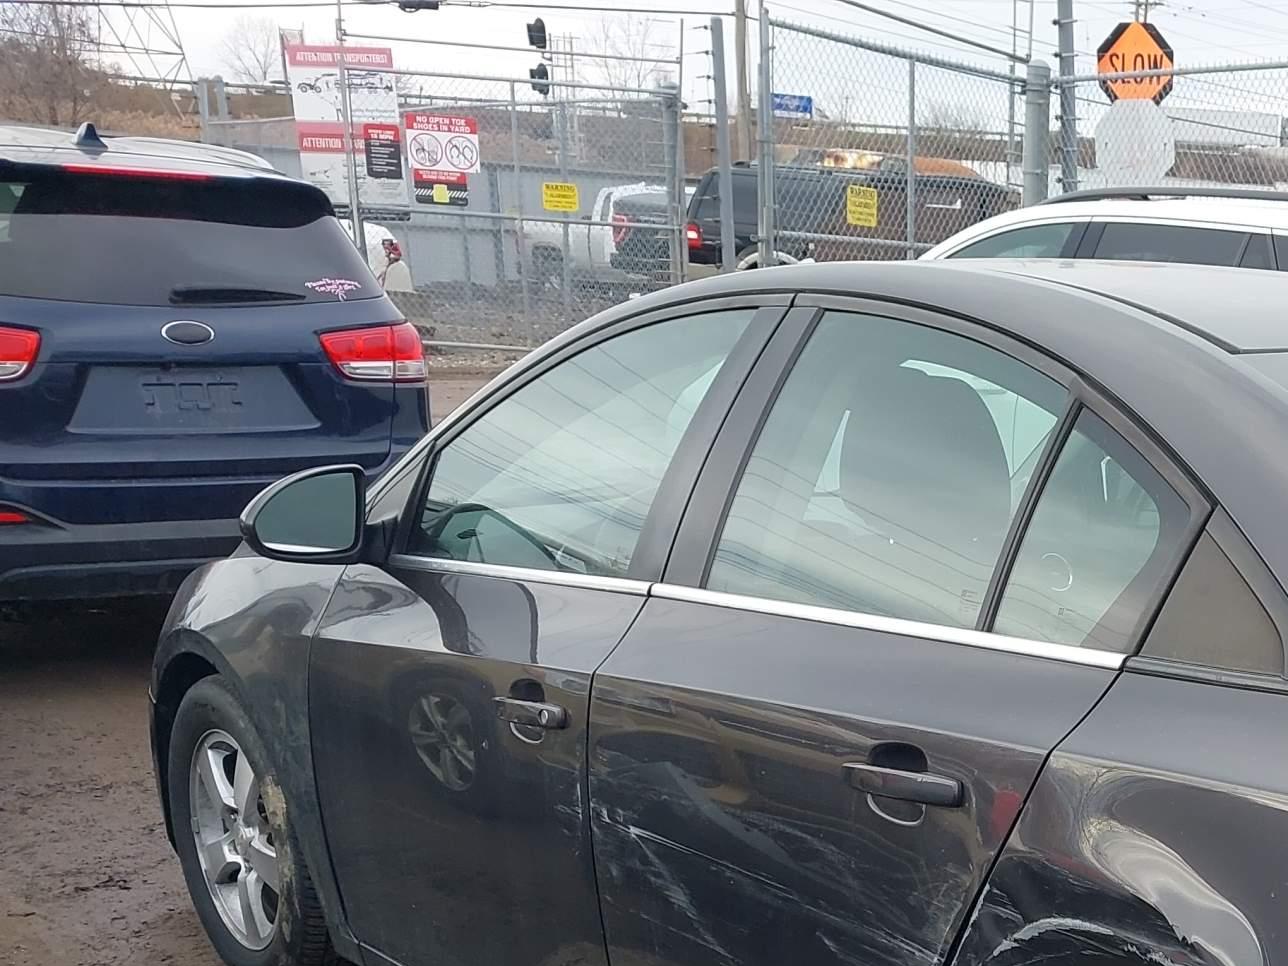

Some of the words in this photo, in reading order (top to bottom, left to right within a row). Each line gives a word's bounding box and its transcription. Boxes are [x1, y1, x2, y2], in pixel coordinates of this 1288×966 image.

[296, 51, 332, 62] ATTENTION
[1109, 53, 1164, 85] SLOW
[416, 115, 428, 123] NO
[429, 116, 450, 125] OPEN
[451, 118, 466, 126] TOE
[413, 122, 439, 131] SHOES
[450, 125, 471, 133] YARD
[302, 137, 342, 148] ATTENTION
